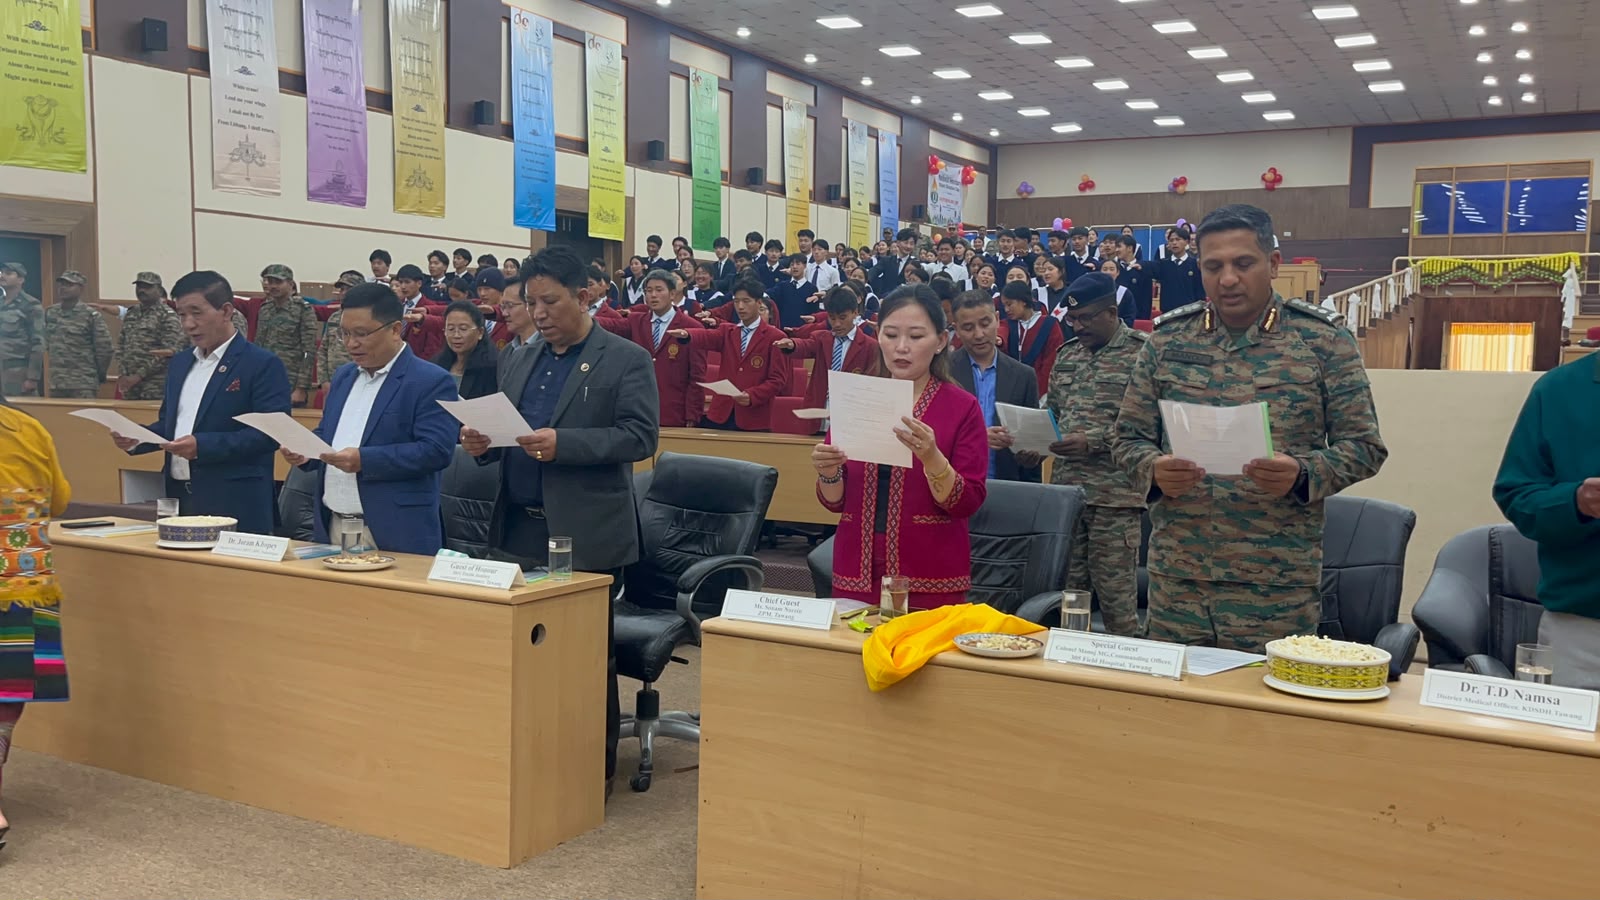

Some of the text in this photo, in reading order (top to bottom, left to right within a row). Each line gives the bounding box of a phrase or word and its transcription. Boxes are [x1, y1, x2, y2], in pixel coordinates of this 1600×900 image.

[475, 565, 498, 574] Honour
[760, 596, 800, 607] Chief Guest
[1091, 641, 1116, 650] Special
[1128, 662, 1152, 671] Tawang
[1460, 681, 1480, 694] Dr.
[1513, 688, 1561, 706] Namsa
[1465, 696, 1492, 706] Medical
